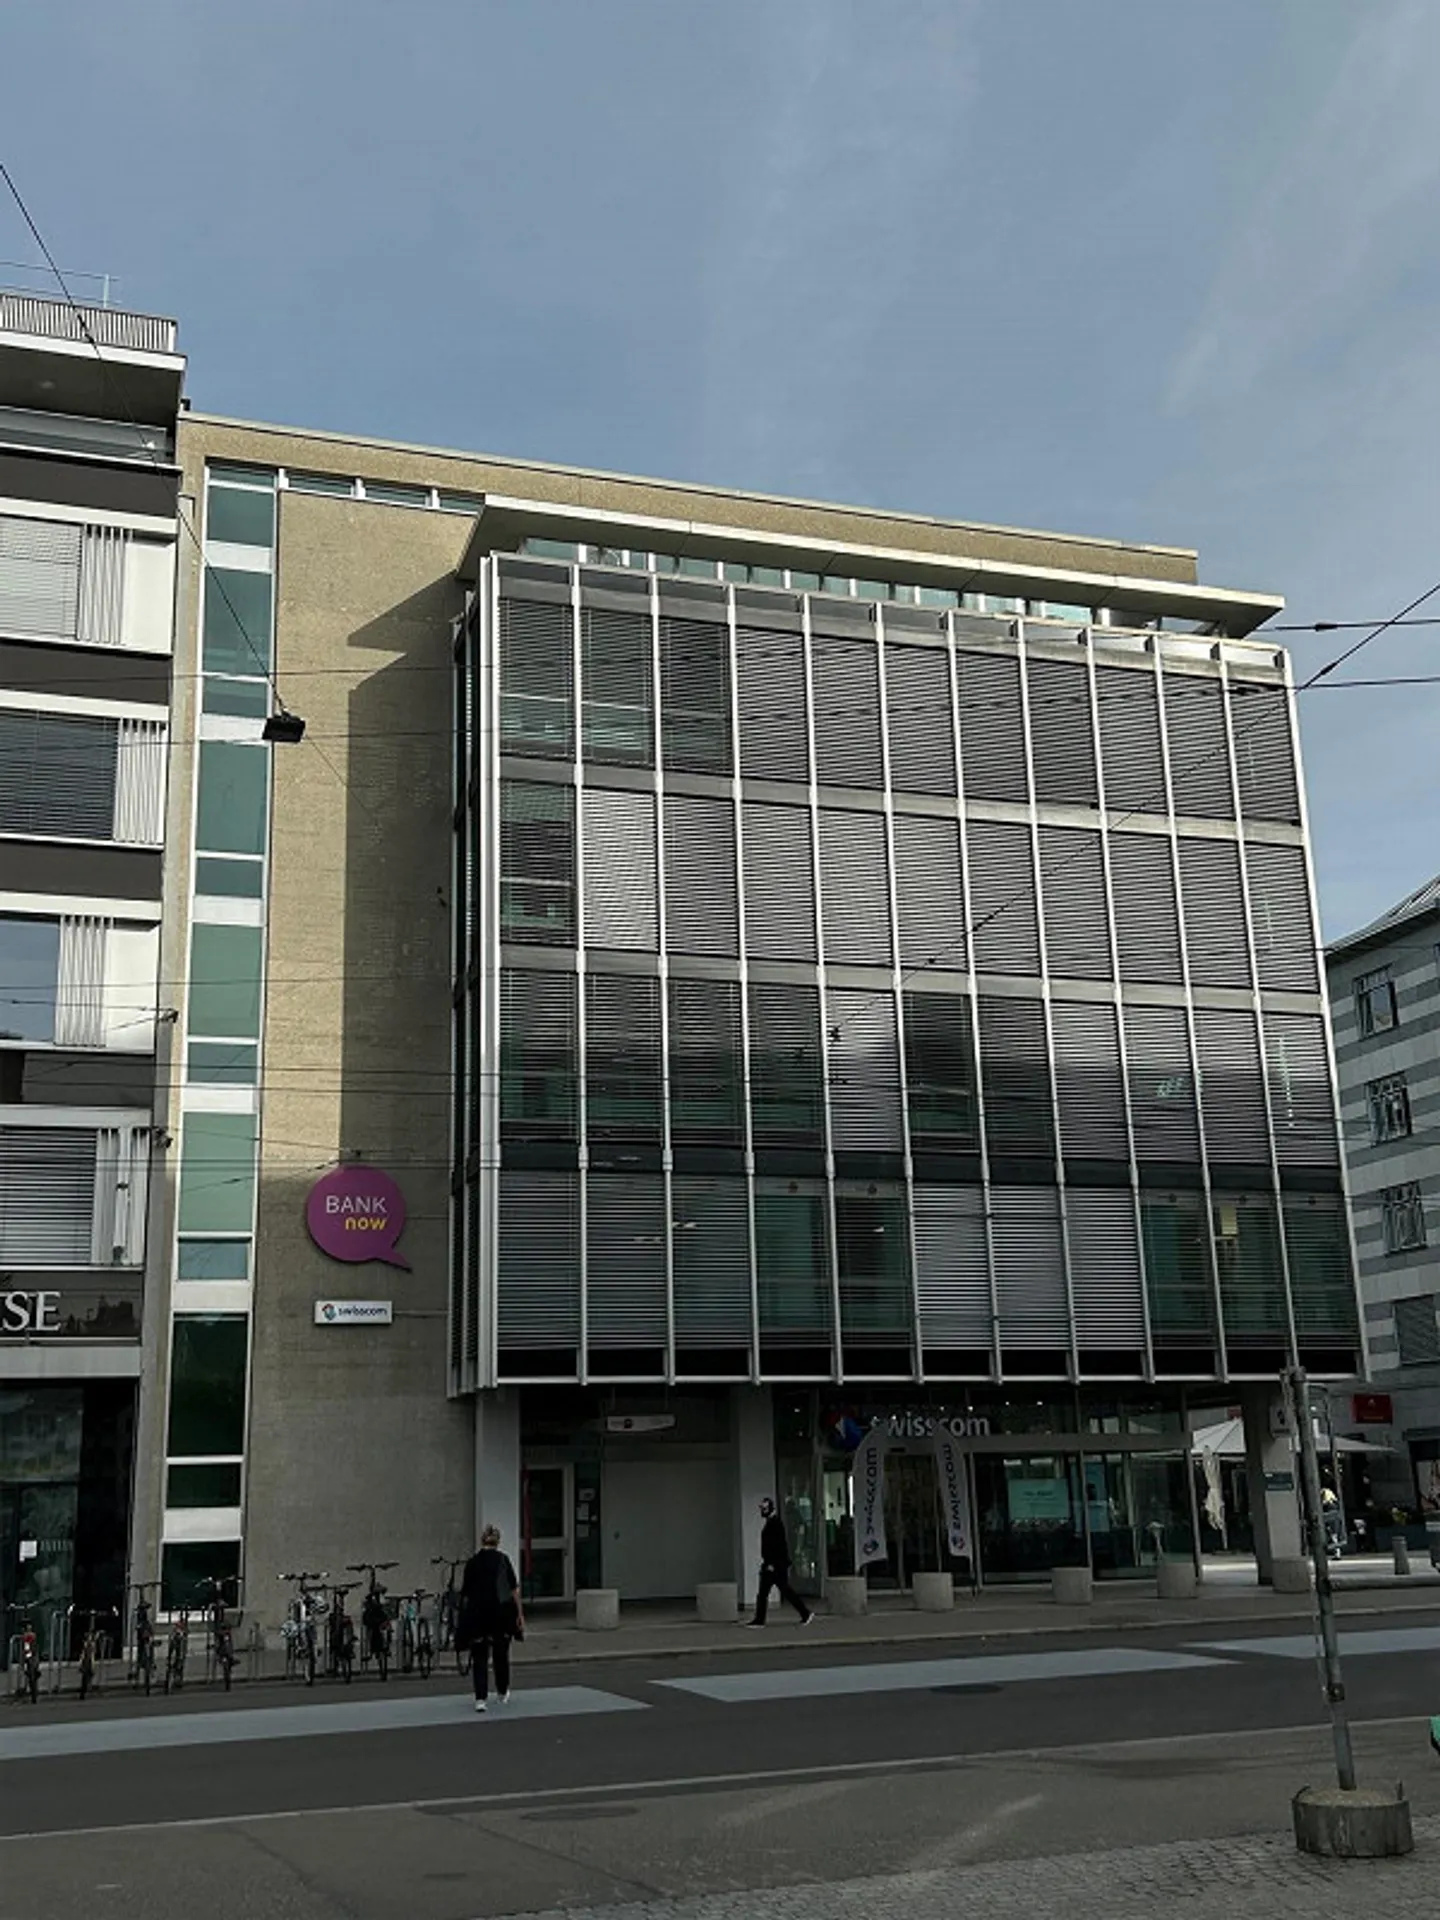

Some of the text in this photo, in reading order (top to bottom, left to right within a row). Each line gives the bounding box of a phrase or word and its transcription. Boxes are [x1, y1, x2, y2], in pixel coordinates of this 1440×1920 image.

[325, 1195, 388, 1214] BANK
[344, 1216, 388, 1231] now
[337, 1304, 388, 1317] swisscom
